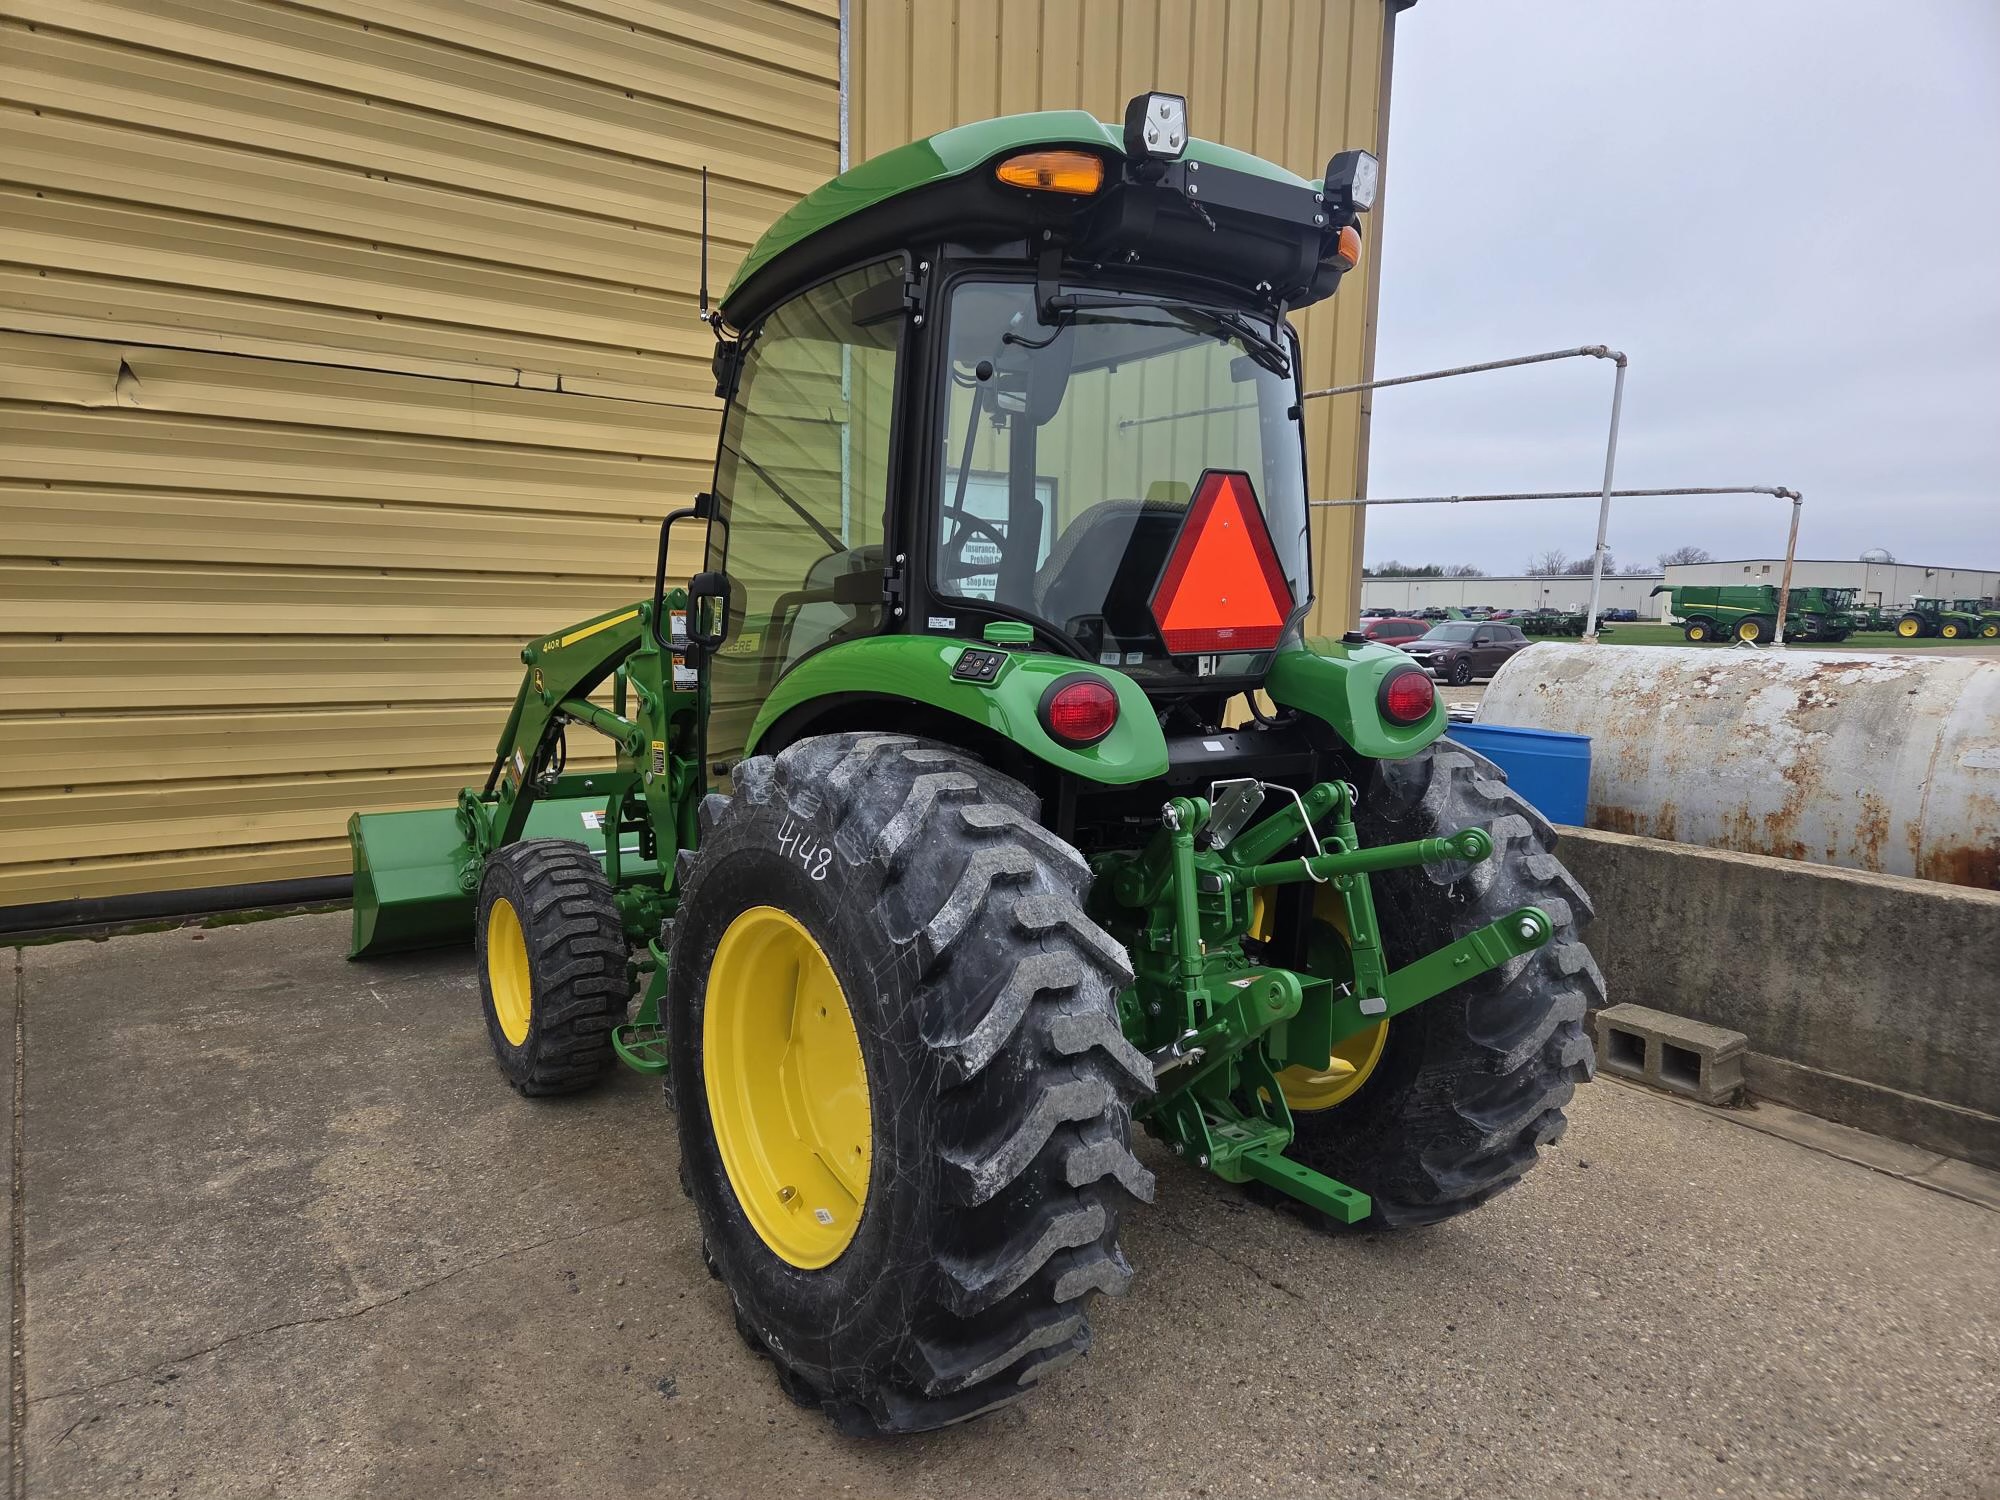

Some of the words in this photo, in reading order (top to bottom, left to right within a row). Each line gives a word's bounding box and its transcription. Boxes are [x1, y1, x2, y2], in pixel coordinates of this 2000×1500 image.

[966, 544, 995, 553] Insurance
[970, 555, 994, 564] Prohibit
[966, 577, 981, 587] Shop
[982, 577, 996, 586] Area
[543, 639, 560, 653] 440R
[778, 814, 832, 880] 4148
